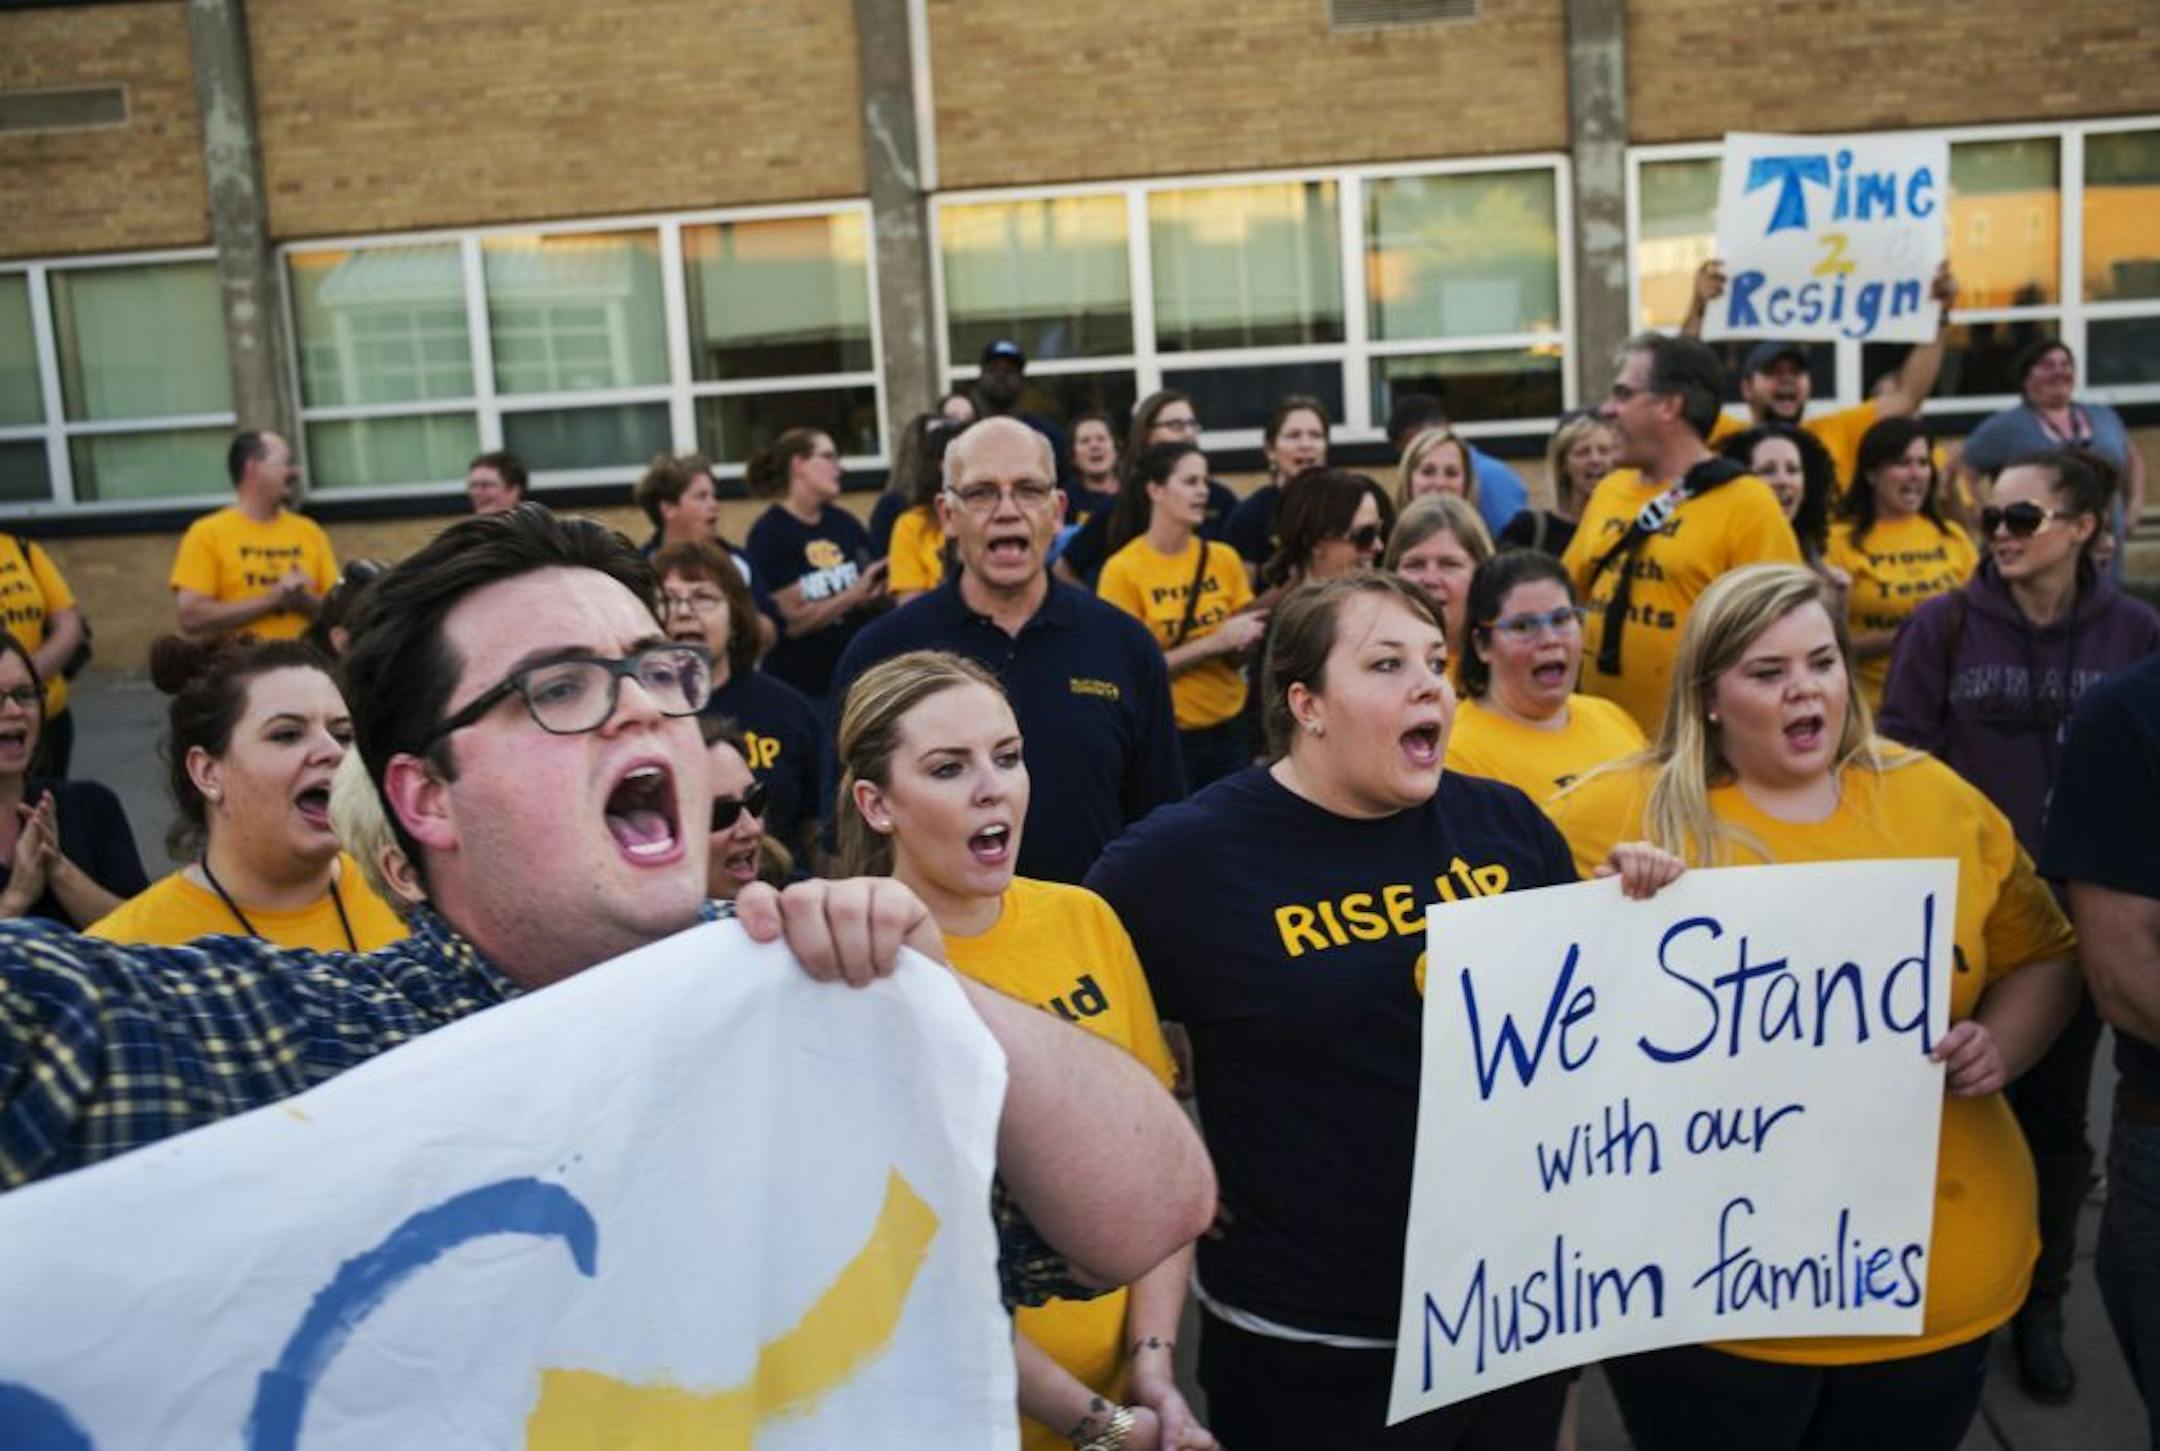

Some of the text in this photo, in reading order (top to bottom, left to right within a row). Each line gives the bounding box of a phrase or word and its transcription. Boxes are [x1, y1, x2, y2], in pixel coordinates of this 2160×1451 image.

[1742, 150, 1935, 236] Time
[1809, 234, 1857, 277] 2
[1726, 270, 1921, 338] Resign
[1275, 884, 1427, 957] RISE
[1459, 892, 1935, 1101] We Stand
[1537, 1097, 1806, 1193] with our
[1421, 1197, 1924, 1393] Muslim families
